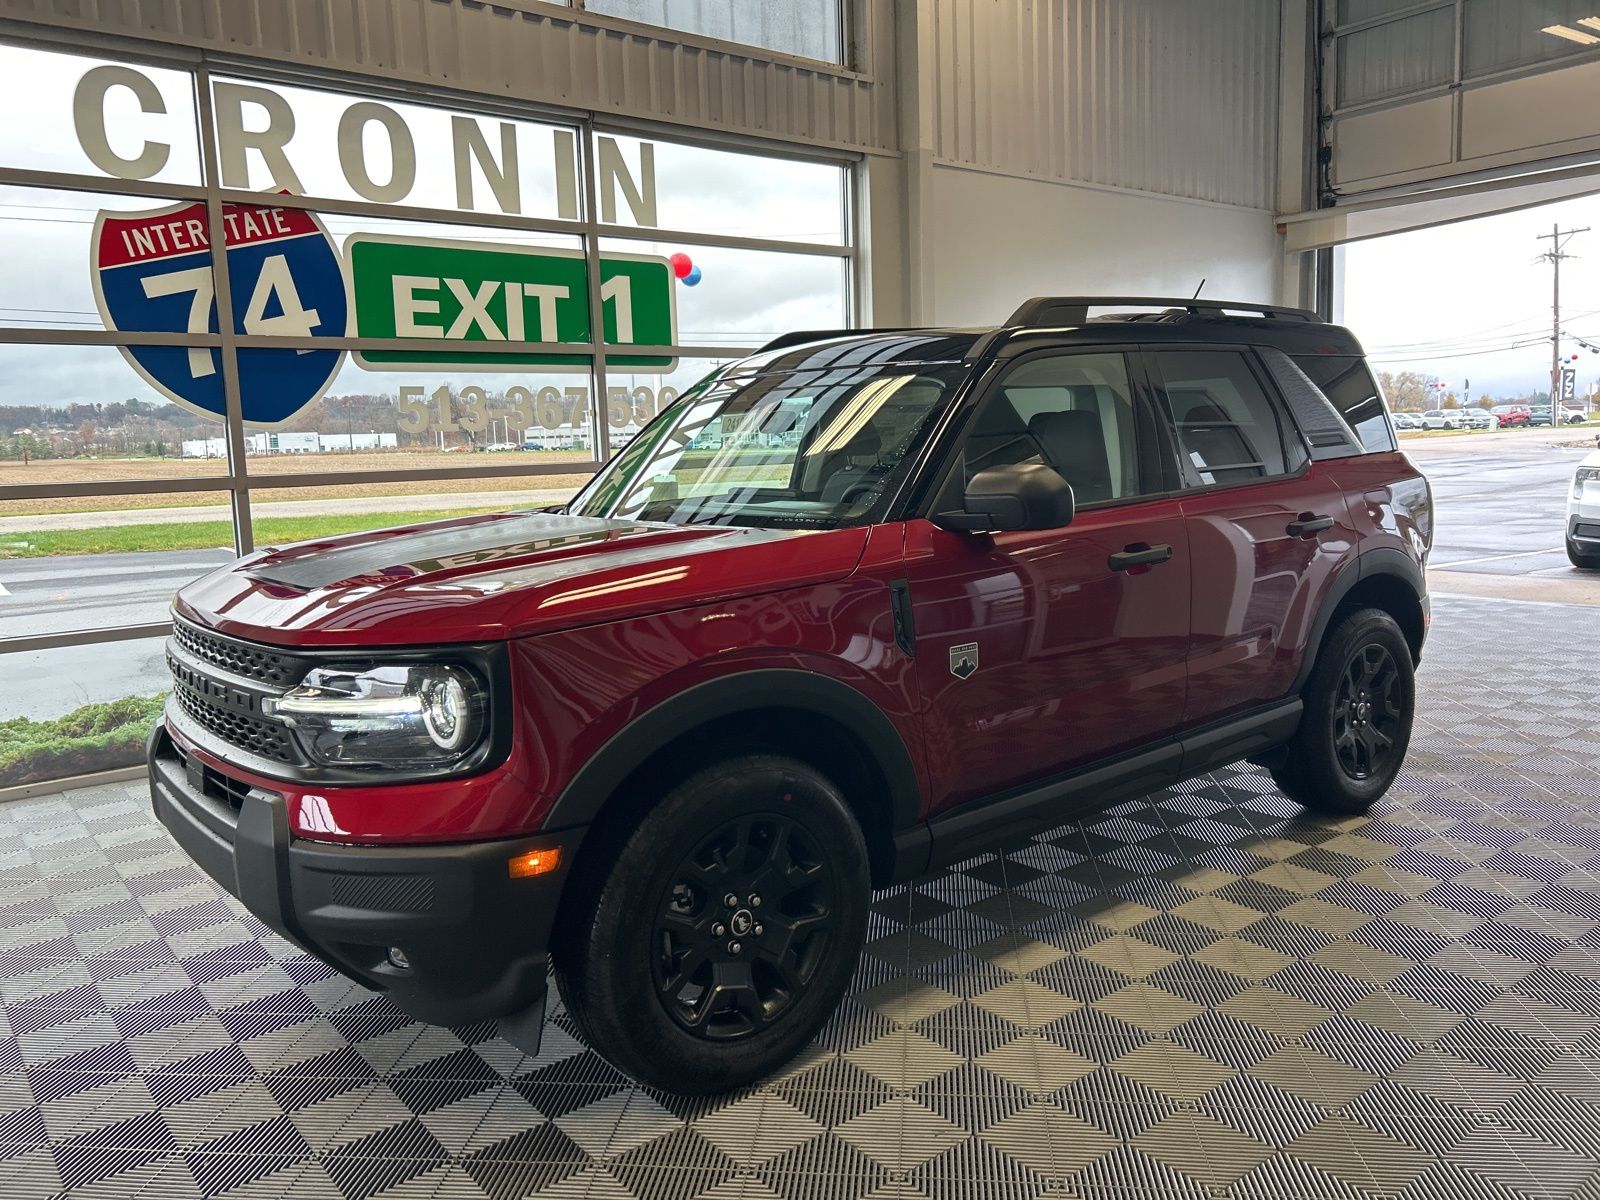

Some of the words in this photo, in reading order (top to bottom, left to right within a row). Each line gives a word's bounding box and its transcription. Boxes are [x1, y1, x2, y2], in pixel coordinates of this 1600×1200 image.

[73, 65, 657, 227] CRONIN
[121, 208, 291, 258] INTERTATE
[140, 254, 321, 379] 74
[392, 274, 570, 343] EXIT
[600, 275, 634, 344] 1
